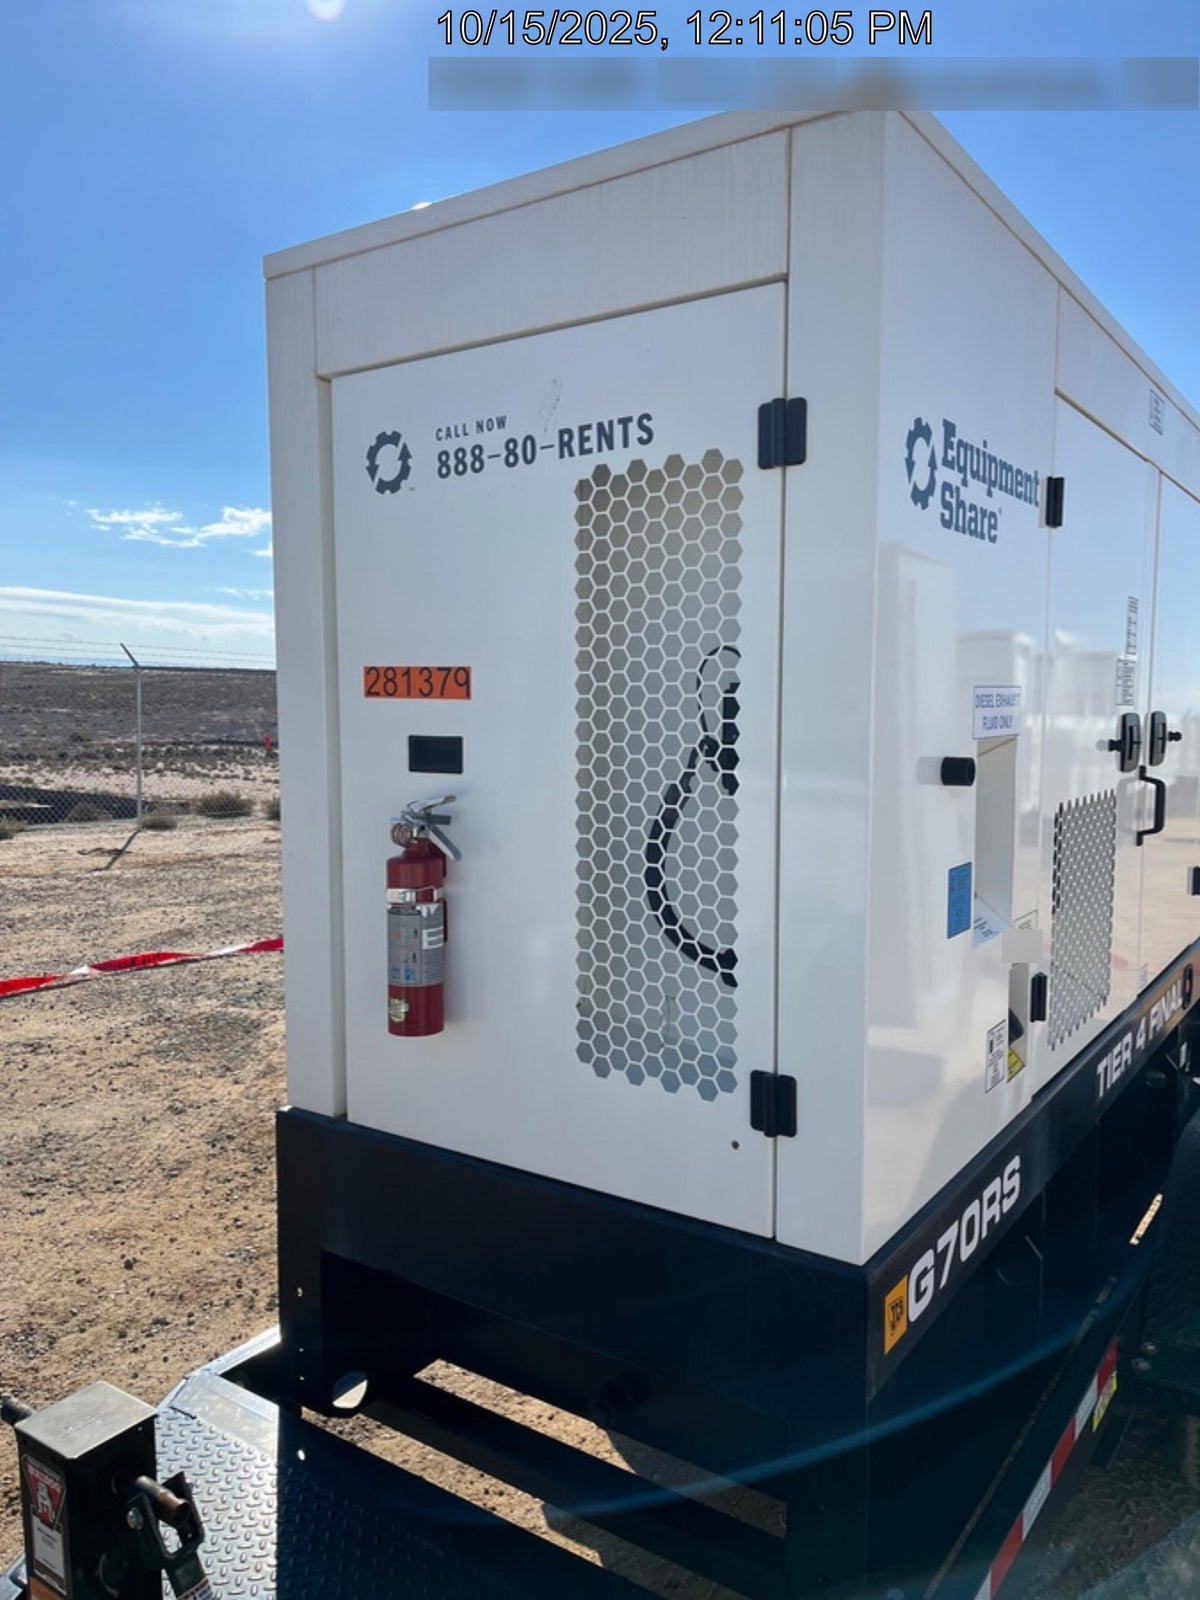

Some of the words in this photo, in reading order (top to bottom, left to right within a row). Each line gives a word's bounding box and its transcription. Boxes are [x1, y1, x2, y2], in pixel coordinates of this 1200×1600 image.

[435, 423, 469, 441] CALL
[476, 415, 507, 434] NOW
[437, 413, 654, 479] 888-80-RENTS
[942, 418, 1040, 507] Equipment
[940, 481, 998, 544] Share
[366, 667, 470, 698] 281379
[975, 693, 995, 708] DIESEL
[999, 714, 1014, 729] ONLY
[1097, 1031, 1132, 1098] TIER
[1136, 1016, 1147, 1050] 4
[908, 1155, 1021, 1322] G70RS
